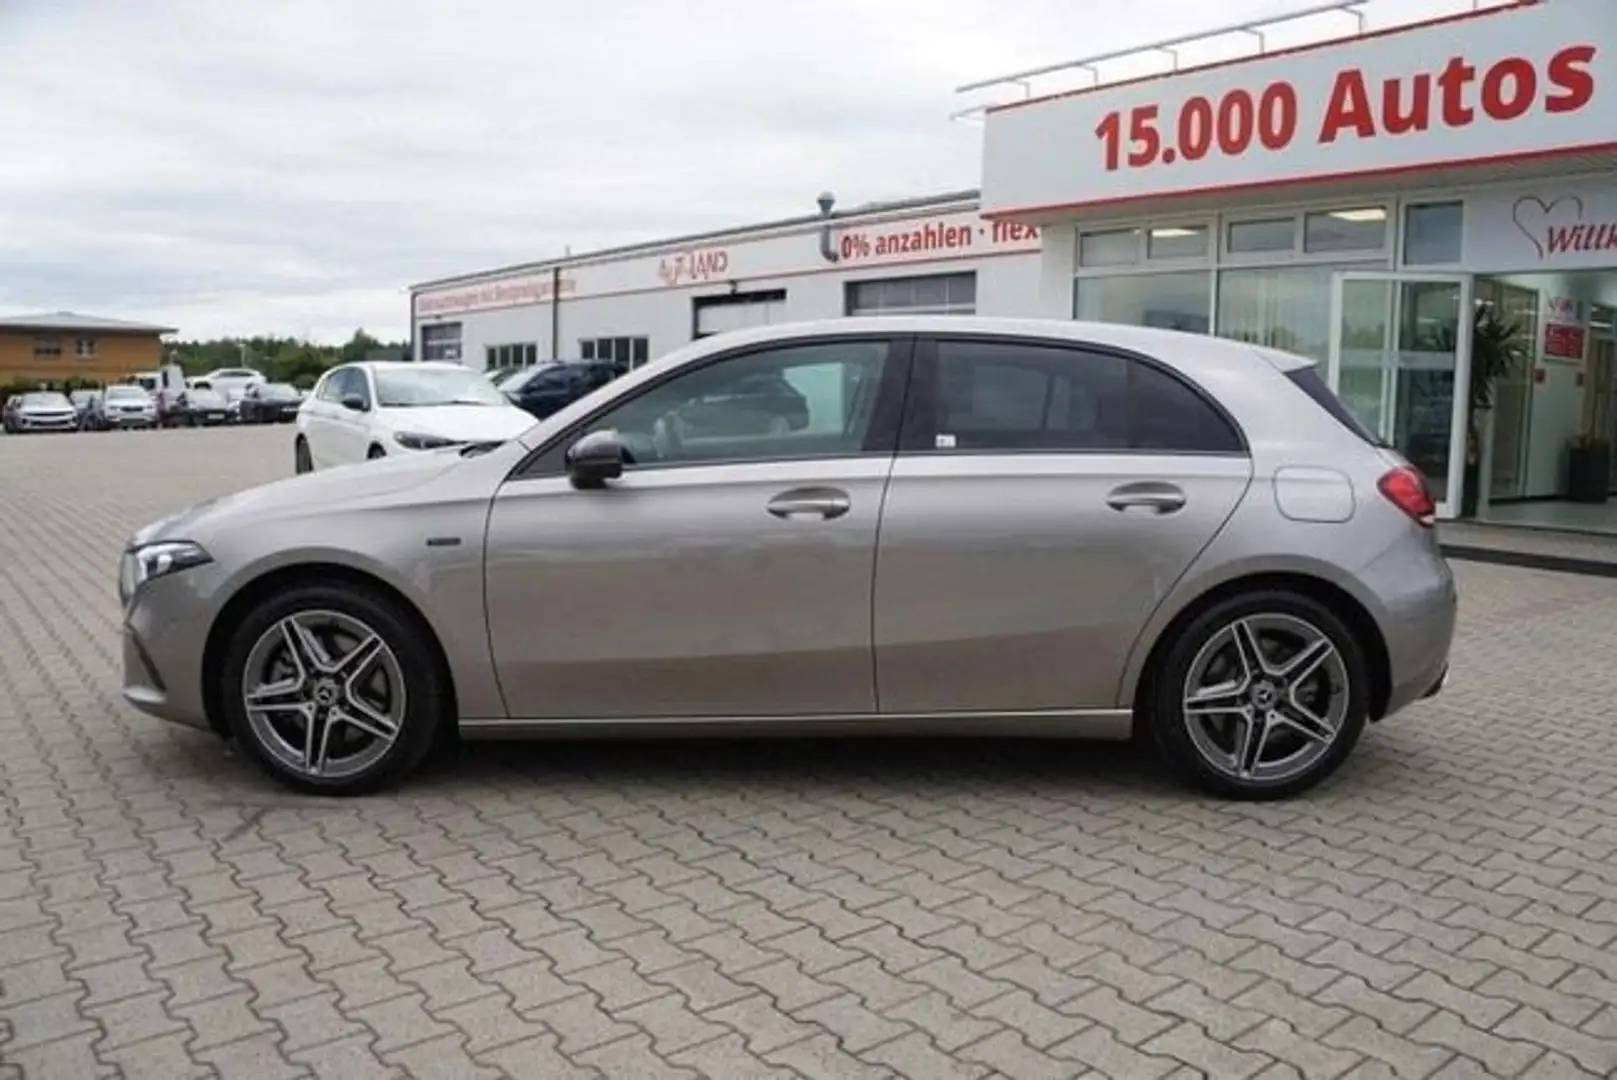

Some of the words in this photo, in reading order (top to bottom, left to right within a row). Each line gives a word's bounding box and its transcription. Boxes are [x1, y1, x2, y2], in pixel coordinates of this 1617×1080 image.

[1096, 82, 1297, 171] 15.000
[1319, 46, 1596, 143] Autos
[840, 234, 870, 259] 0%
[875, 222, 972, 256] anzahlen
